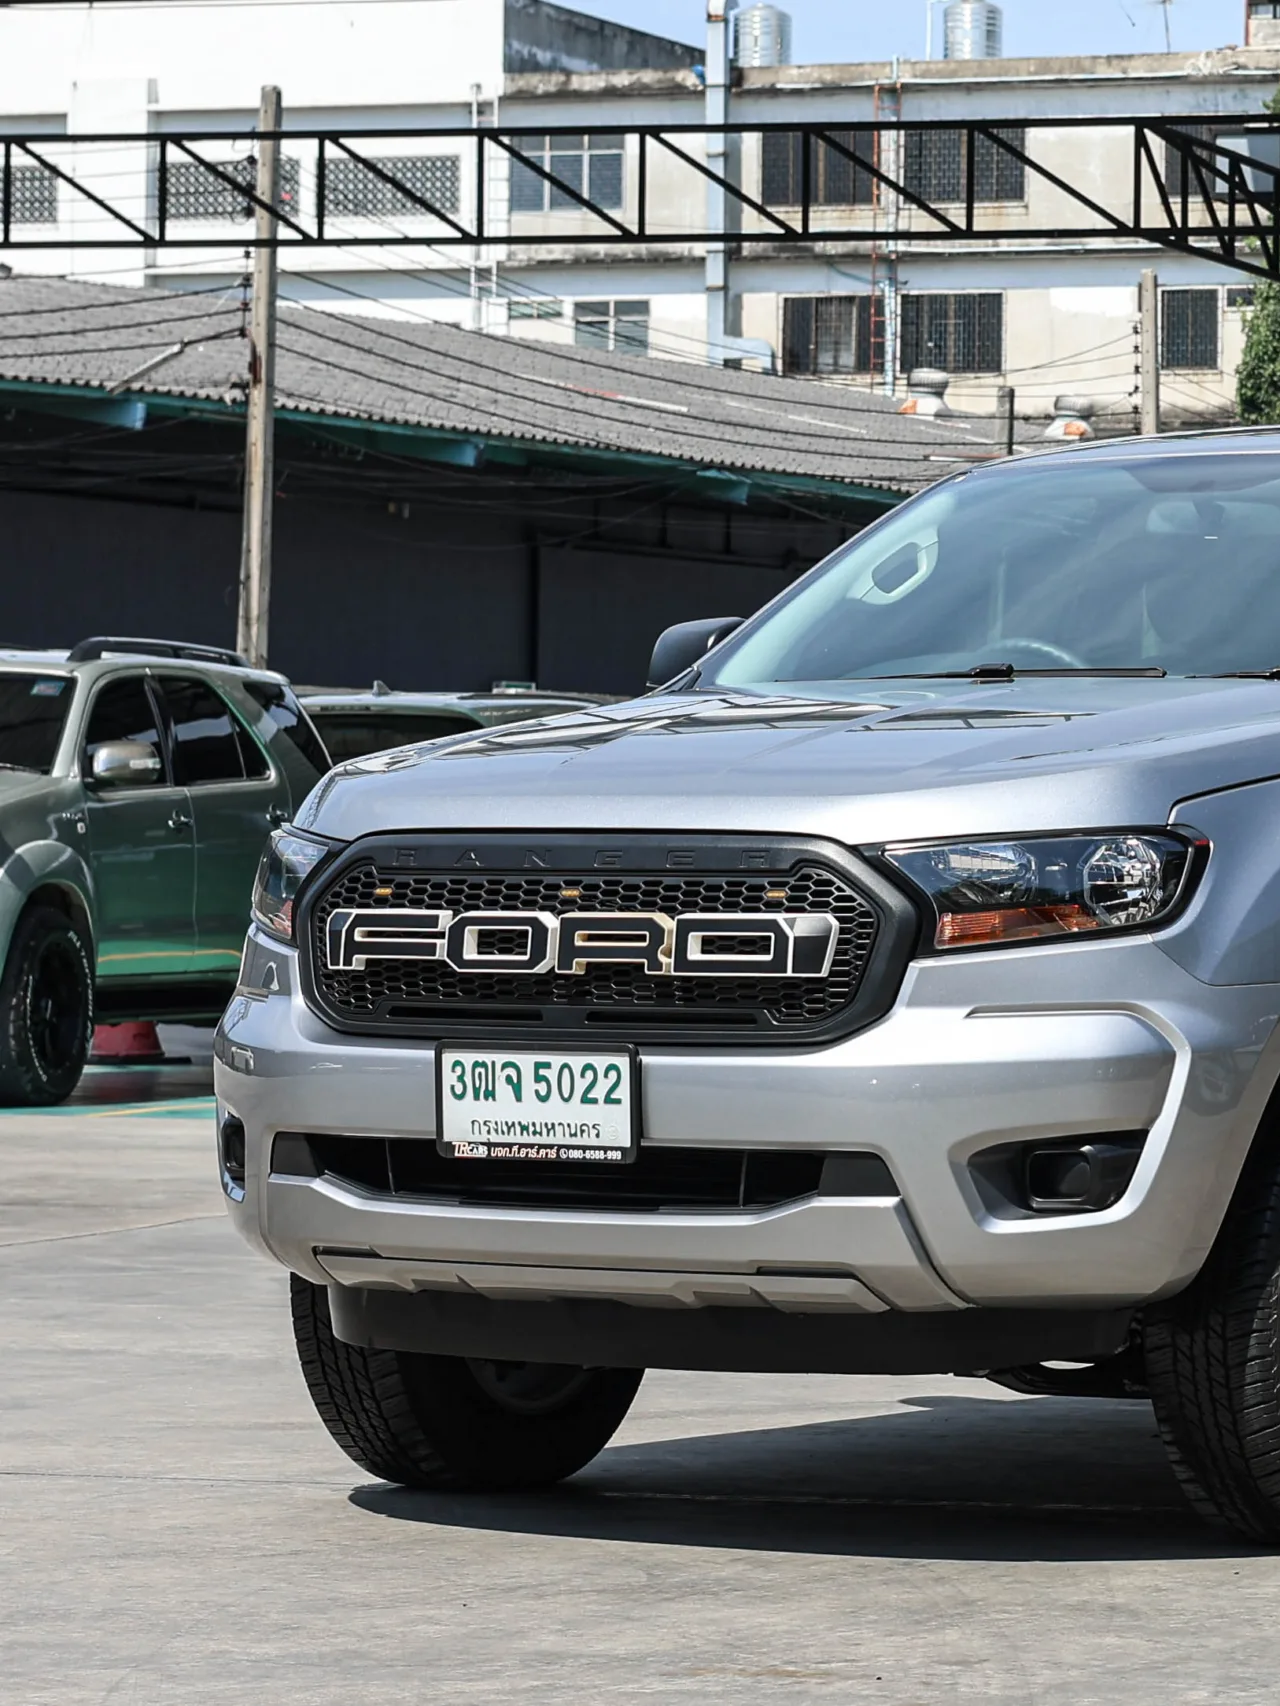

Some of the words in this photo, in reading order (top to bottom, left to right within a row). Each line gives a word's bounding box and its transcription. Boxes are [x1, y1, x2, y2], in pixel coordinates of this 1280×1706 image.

[393, 847, 772, 869] RANGER
[326, 908, 841, 978] FORD
[534, 1061, 622, 1105] 5022
[471, 1119, 601, 1142] กรุงเทพมหานคร
